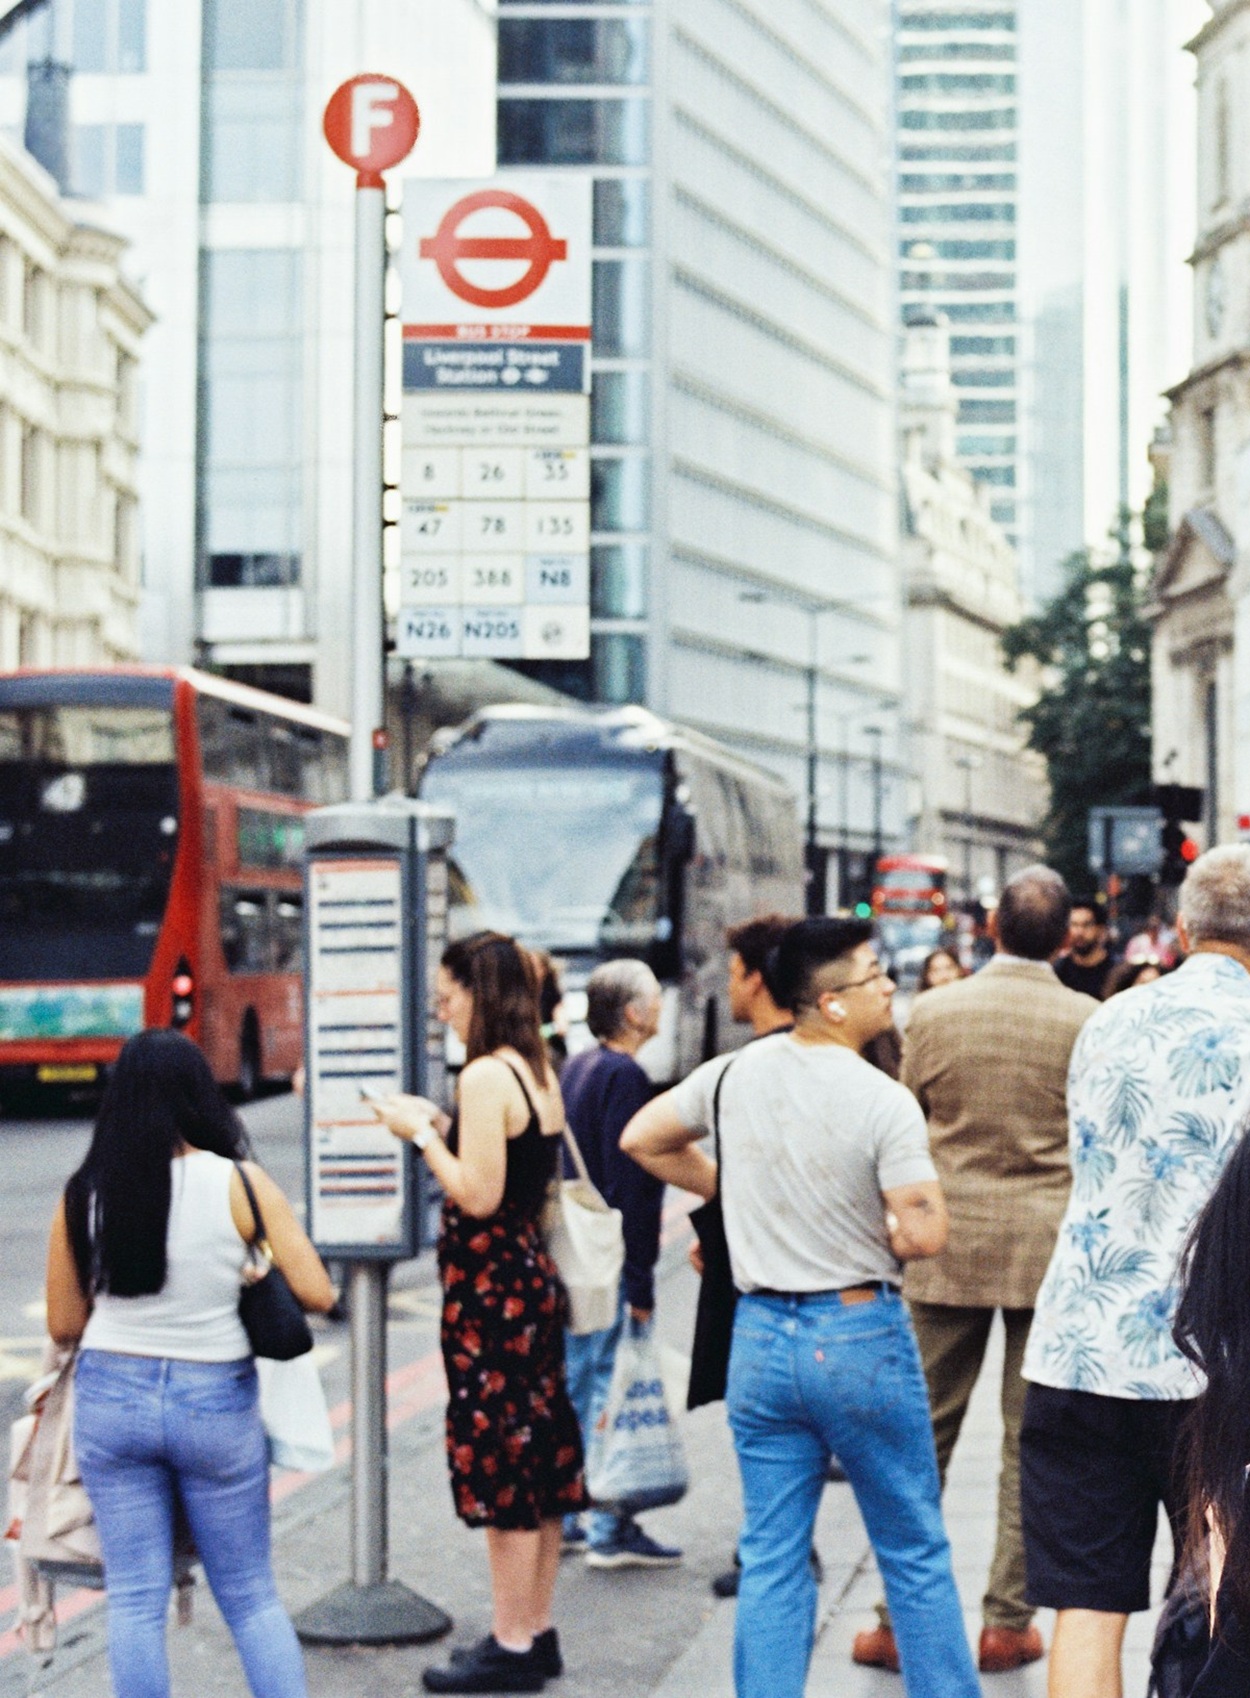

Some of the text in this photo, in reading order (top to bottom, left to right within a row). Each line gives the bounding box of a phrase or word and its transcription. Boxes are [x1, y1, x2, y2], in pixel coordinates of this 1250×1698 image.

[351, 82, 399, 159] F
[423, 348, 561, 368] Liverpool Street
[435, 367, 499, 385] Station
[423, 463, 434, 481] 8
[480, 462, 504, 481] 26
[482, 516, 506, 535] 78
[410, 568, 448, 588] 205
[539, 568, 572, 587] N8
[406, 620, 451, 639] N26
[464, 620, 520, 640] N205
